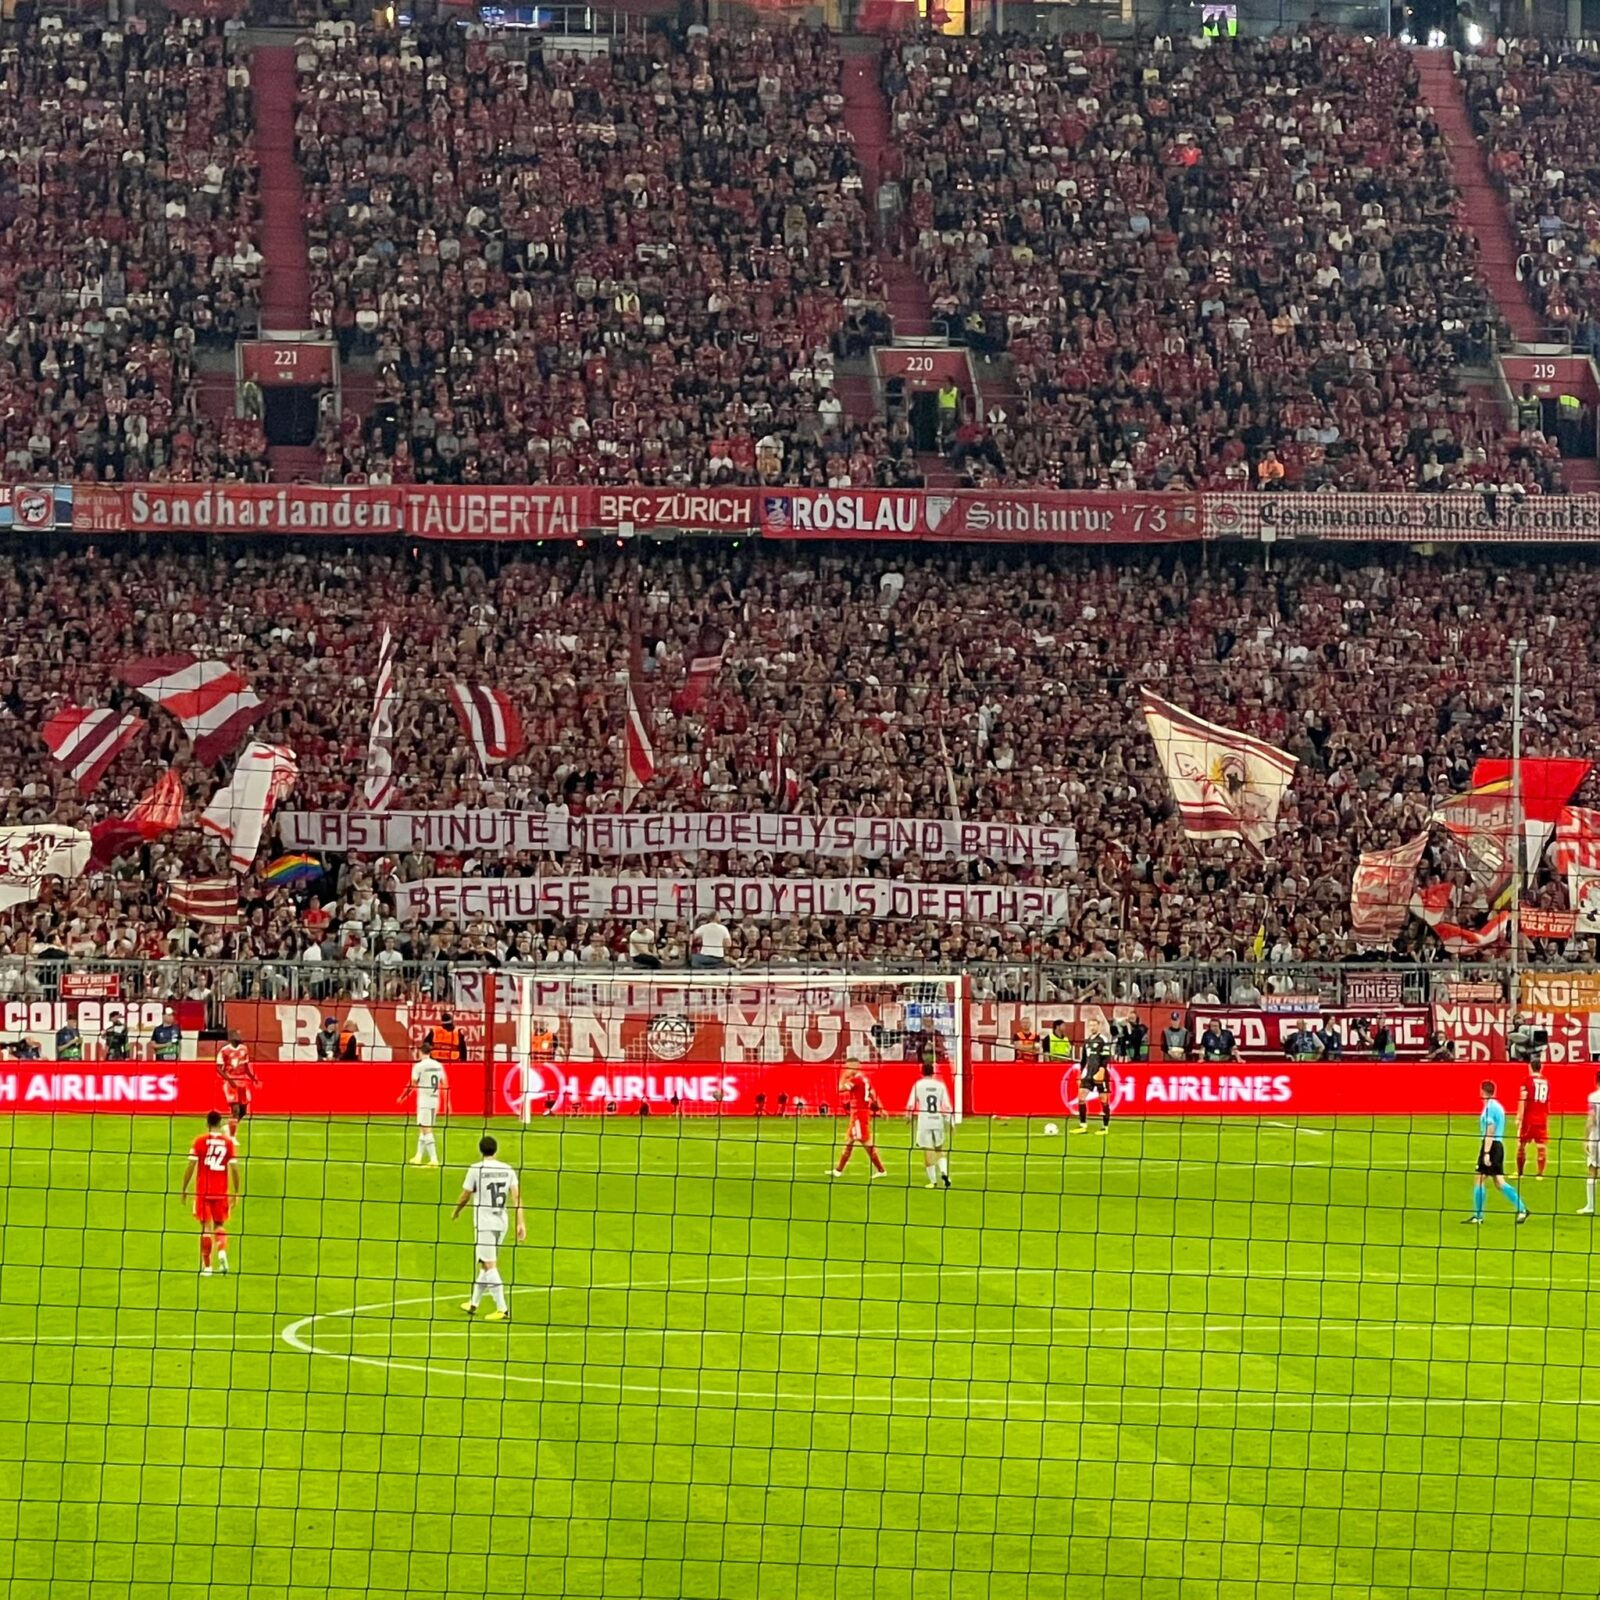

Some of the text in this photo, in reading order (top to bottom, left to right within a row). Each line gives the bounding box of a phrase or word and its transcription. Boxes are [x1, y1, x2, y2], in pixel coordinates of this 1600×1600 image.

[274, 351, 297, 365] 221
[906, 357, 934, 371] 220
[1533, 364, 1555, 378] 219
[131, 489, 391, 527] Sandharlanden
[600, 493, 751, 524] BFC ZÜRICH
[792, 494, 918, 532] RÖSLAU
[965, 501, 1114, 532] Südkurve
[1259, 501, 1410, 527] Commando
[294, 814, 1061, 859] LAST MINUTE MATCH DELAYS AND BANS
[409, 881, 1054, 924] BECAUSE OF A ROYAL'S DEATH?!
[1346, 984, 1401, 999] JUNGS!
[1525, 980, 1579, 1007] NO!
[24, 1074, 179, 1102] AIRLINES
[430, 1074, 439, 1094] 9
[587, 1075, 740, 1102] AIRLINES
[1145, 1075, 1293, 1102] AIRLINES
[1534, 1082, 1549, 1104] 18
[926, 1094, 938, 1114] 8
[204, 1145, 227, 1172] 42
[486, 1182, 507, 1208] 15
